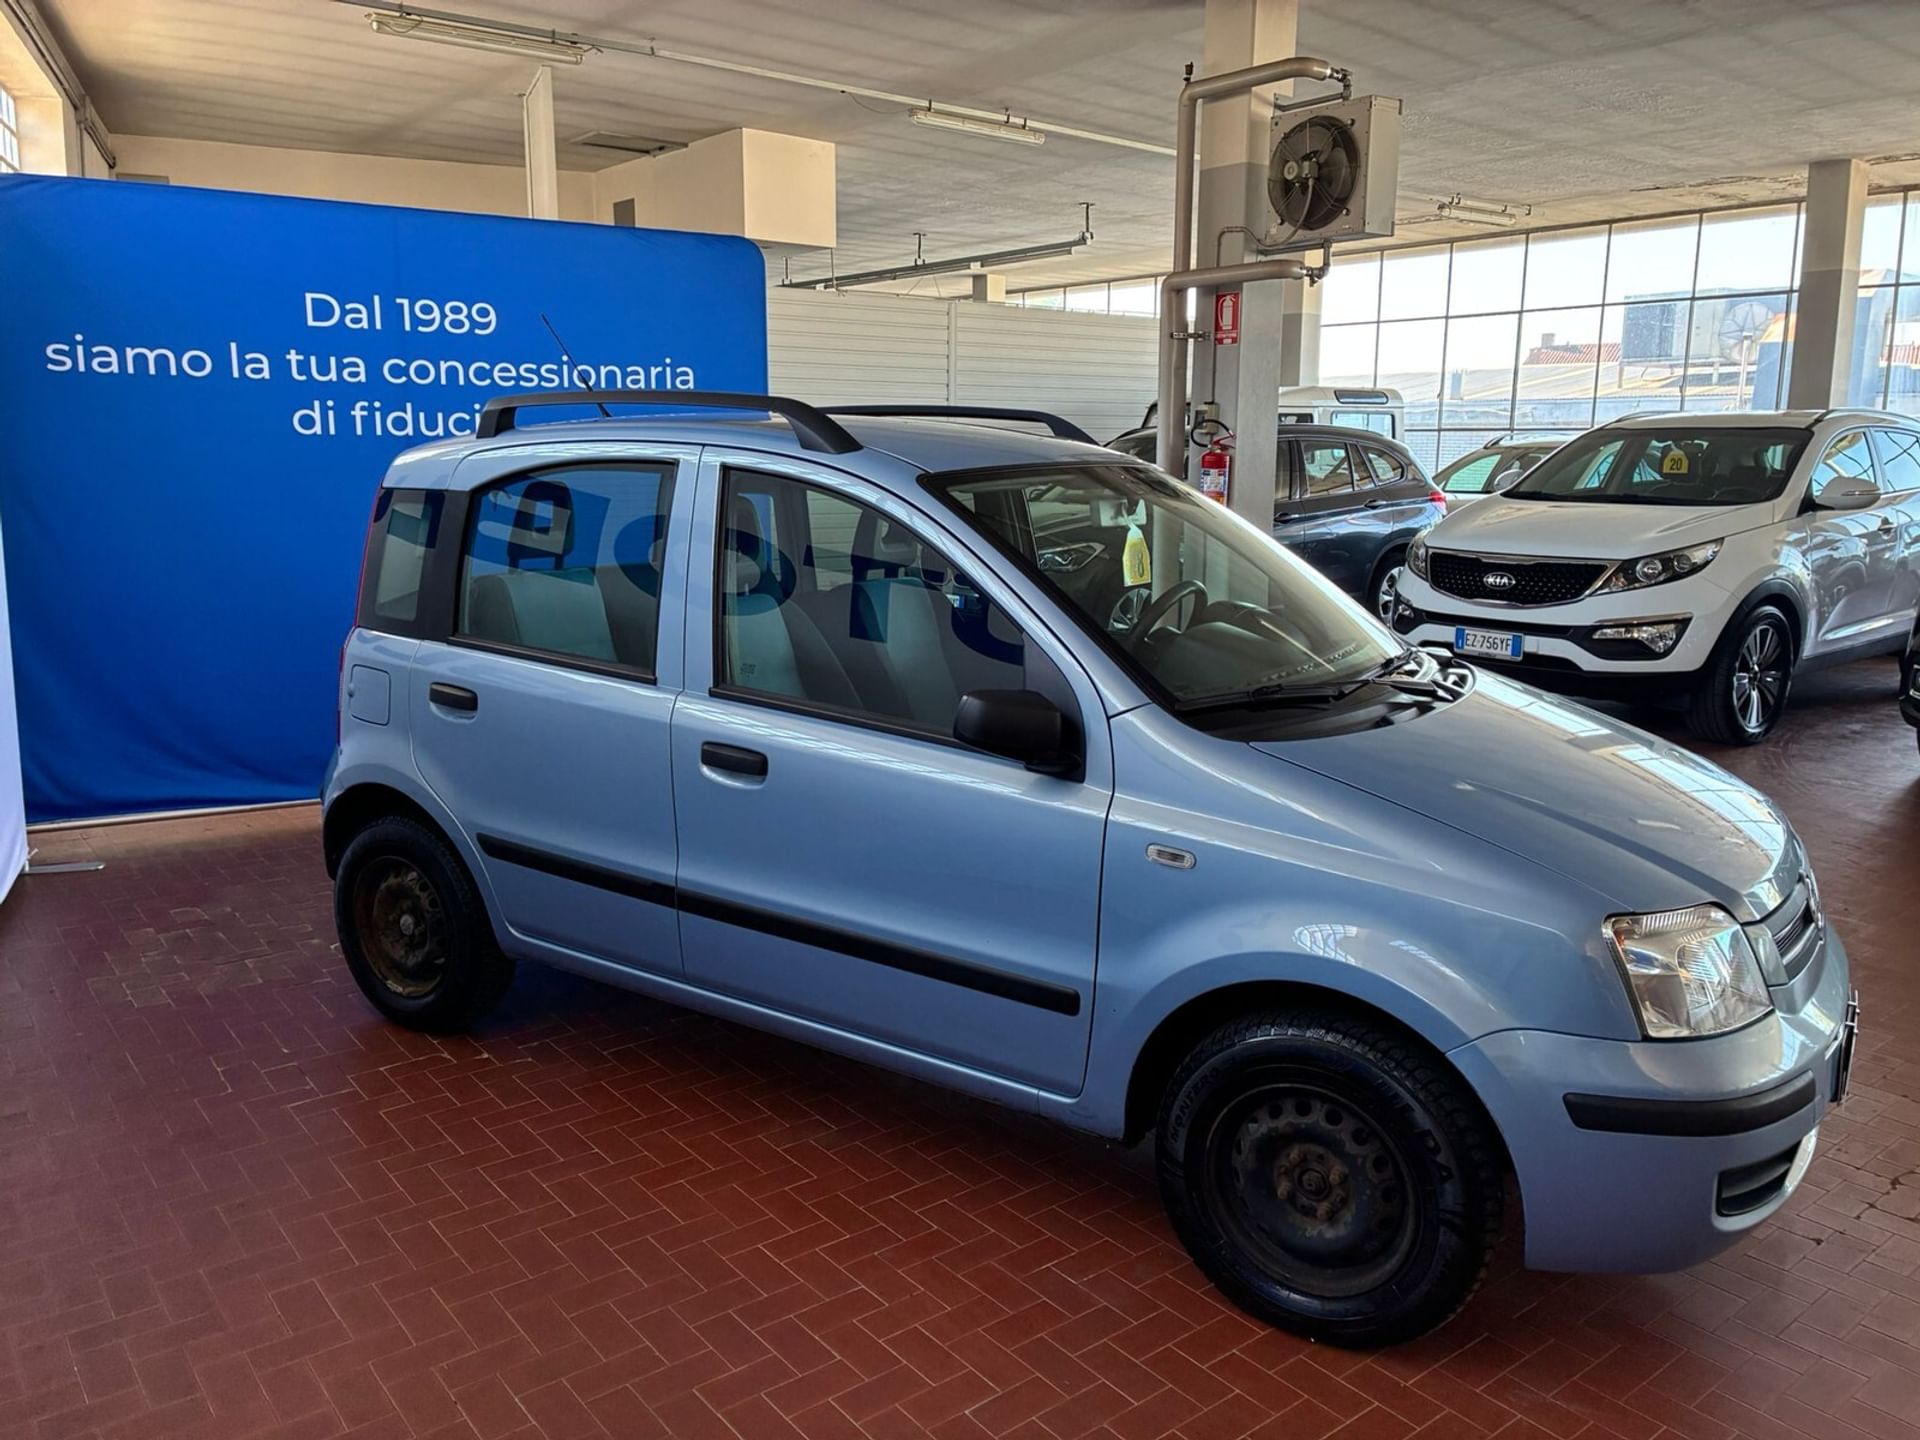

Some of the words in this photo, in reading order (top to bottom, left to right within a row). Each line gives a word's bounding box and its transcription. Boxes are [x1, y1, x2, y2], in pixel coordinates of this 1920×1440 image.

[304, 291, 382, 331] Dal
[395, 297, 497, 336] 1989
[45, 333, 213, 378] siamo
[229, 341, 271, 380] la
[285, 349, 367, 383] tua
[382, 354, 695, 390] concessionaria
[292, 399, 336, 436] di
[1669, 457, 1683, 471] 20
[1485, 574, 1511, 588] KIA
